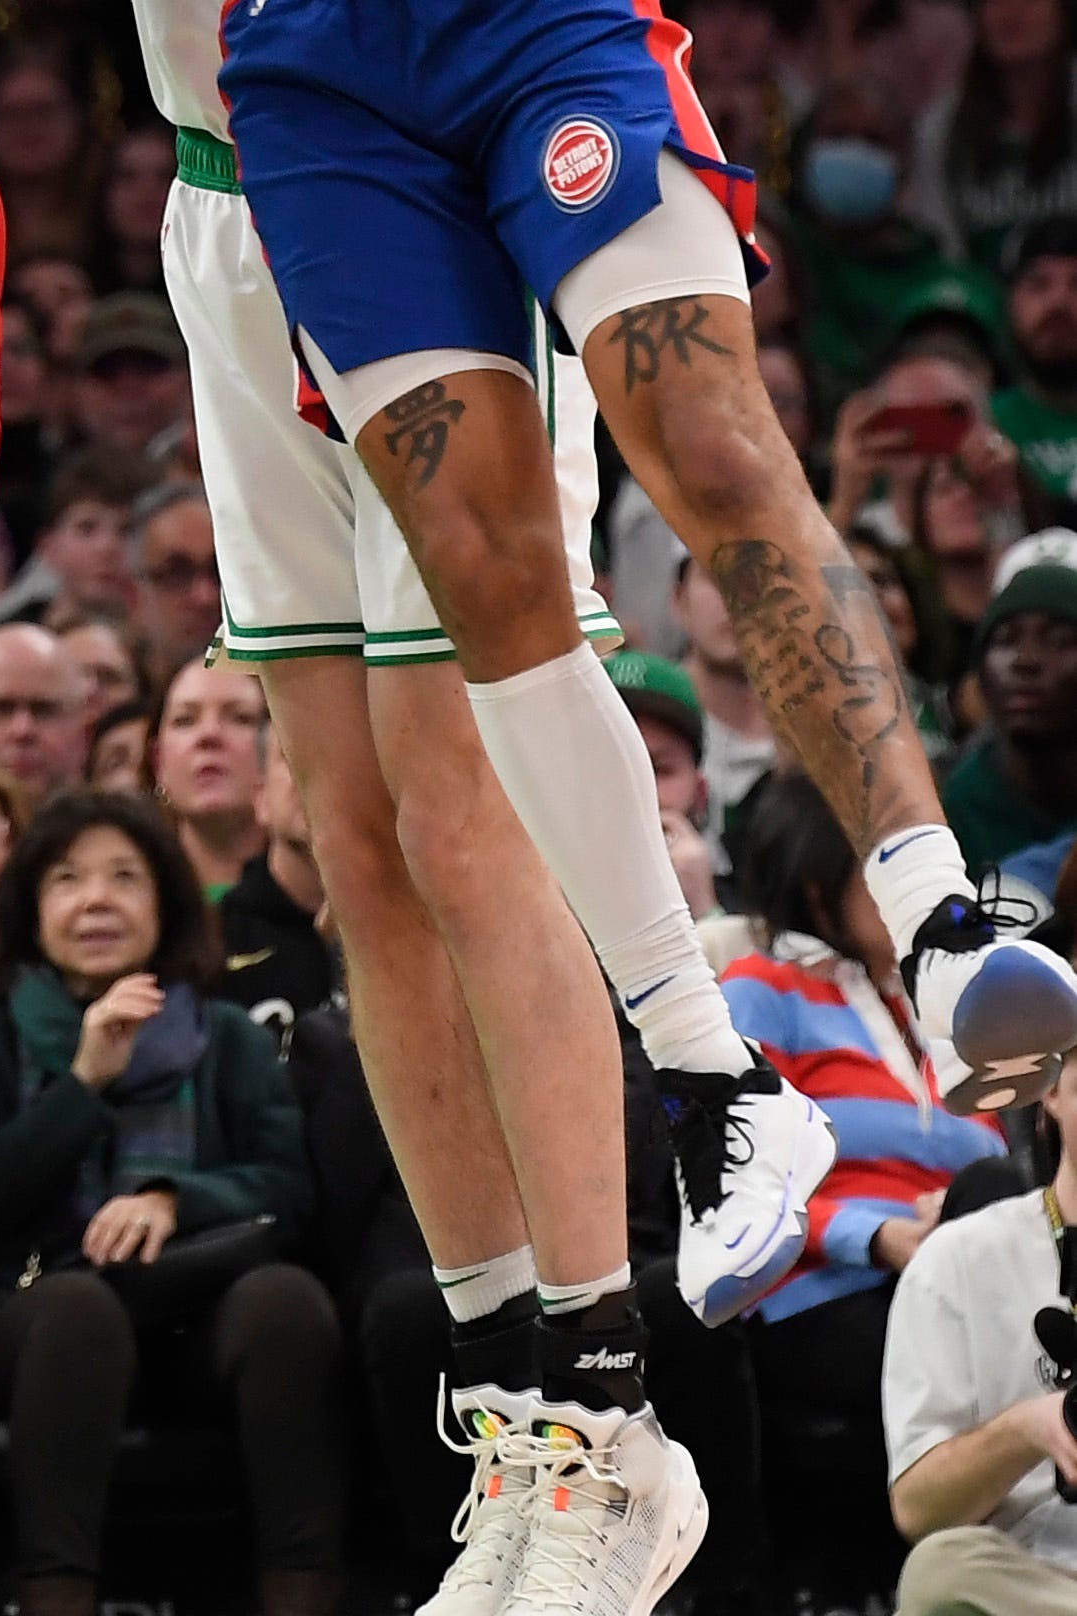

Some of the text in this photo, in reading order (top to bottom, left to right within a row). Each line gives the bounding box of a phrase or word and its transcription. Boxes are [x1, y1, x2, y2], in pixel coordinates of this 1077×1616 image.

[552, 136, 600, 174] DETROIT
[556, 151, 604, 189] PISTONS
[573, 1345, 637, 1370] ZAMST
